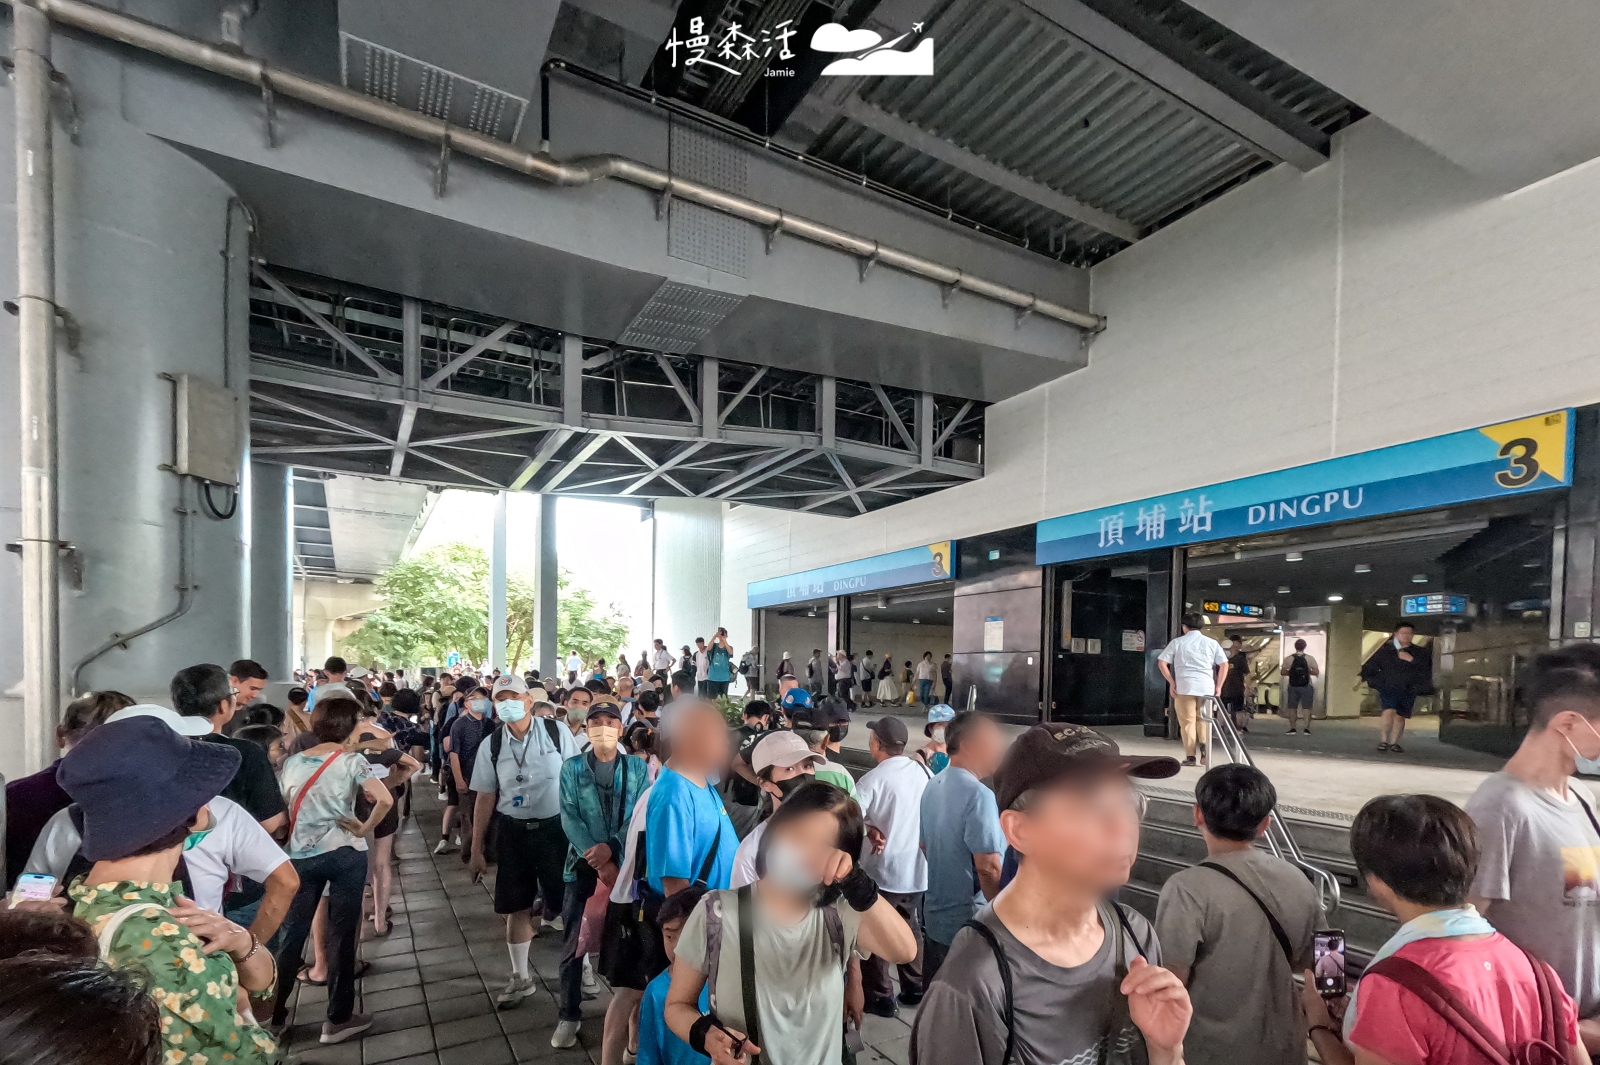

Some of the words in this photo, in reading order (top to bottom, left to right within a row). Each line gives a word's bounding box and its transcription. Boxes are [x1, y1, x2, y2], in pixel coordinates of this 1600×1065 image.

[1494, 437, 1540, 489] 3
[1098, 494, 1213, 549] 頂埔站
[1248, 487, 1364, 525] DINGPU
[833, 576, 867, 592] DINGPU
[931, 551, 944, 578] 3
